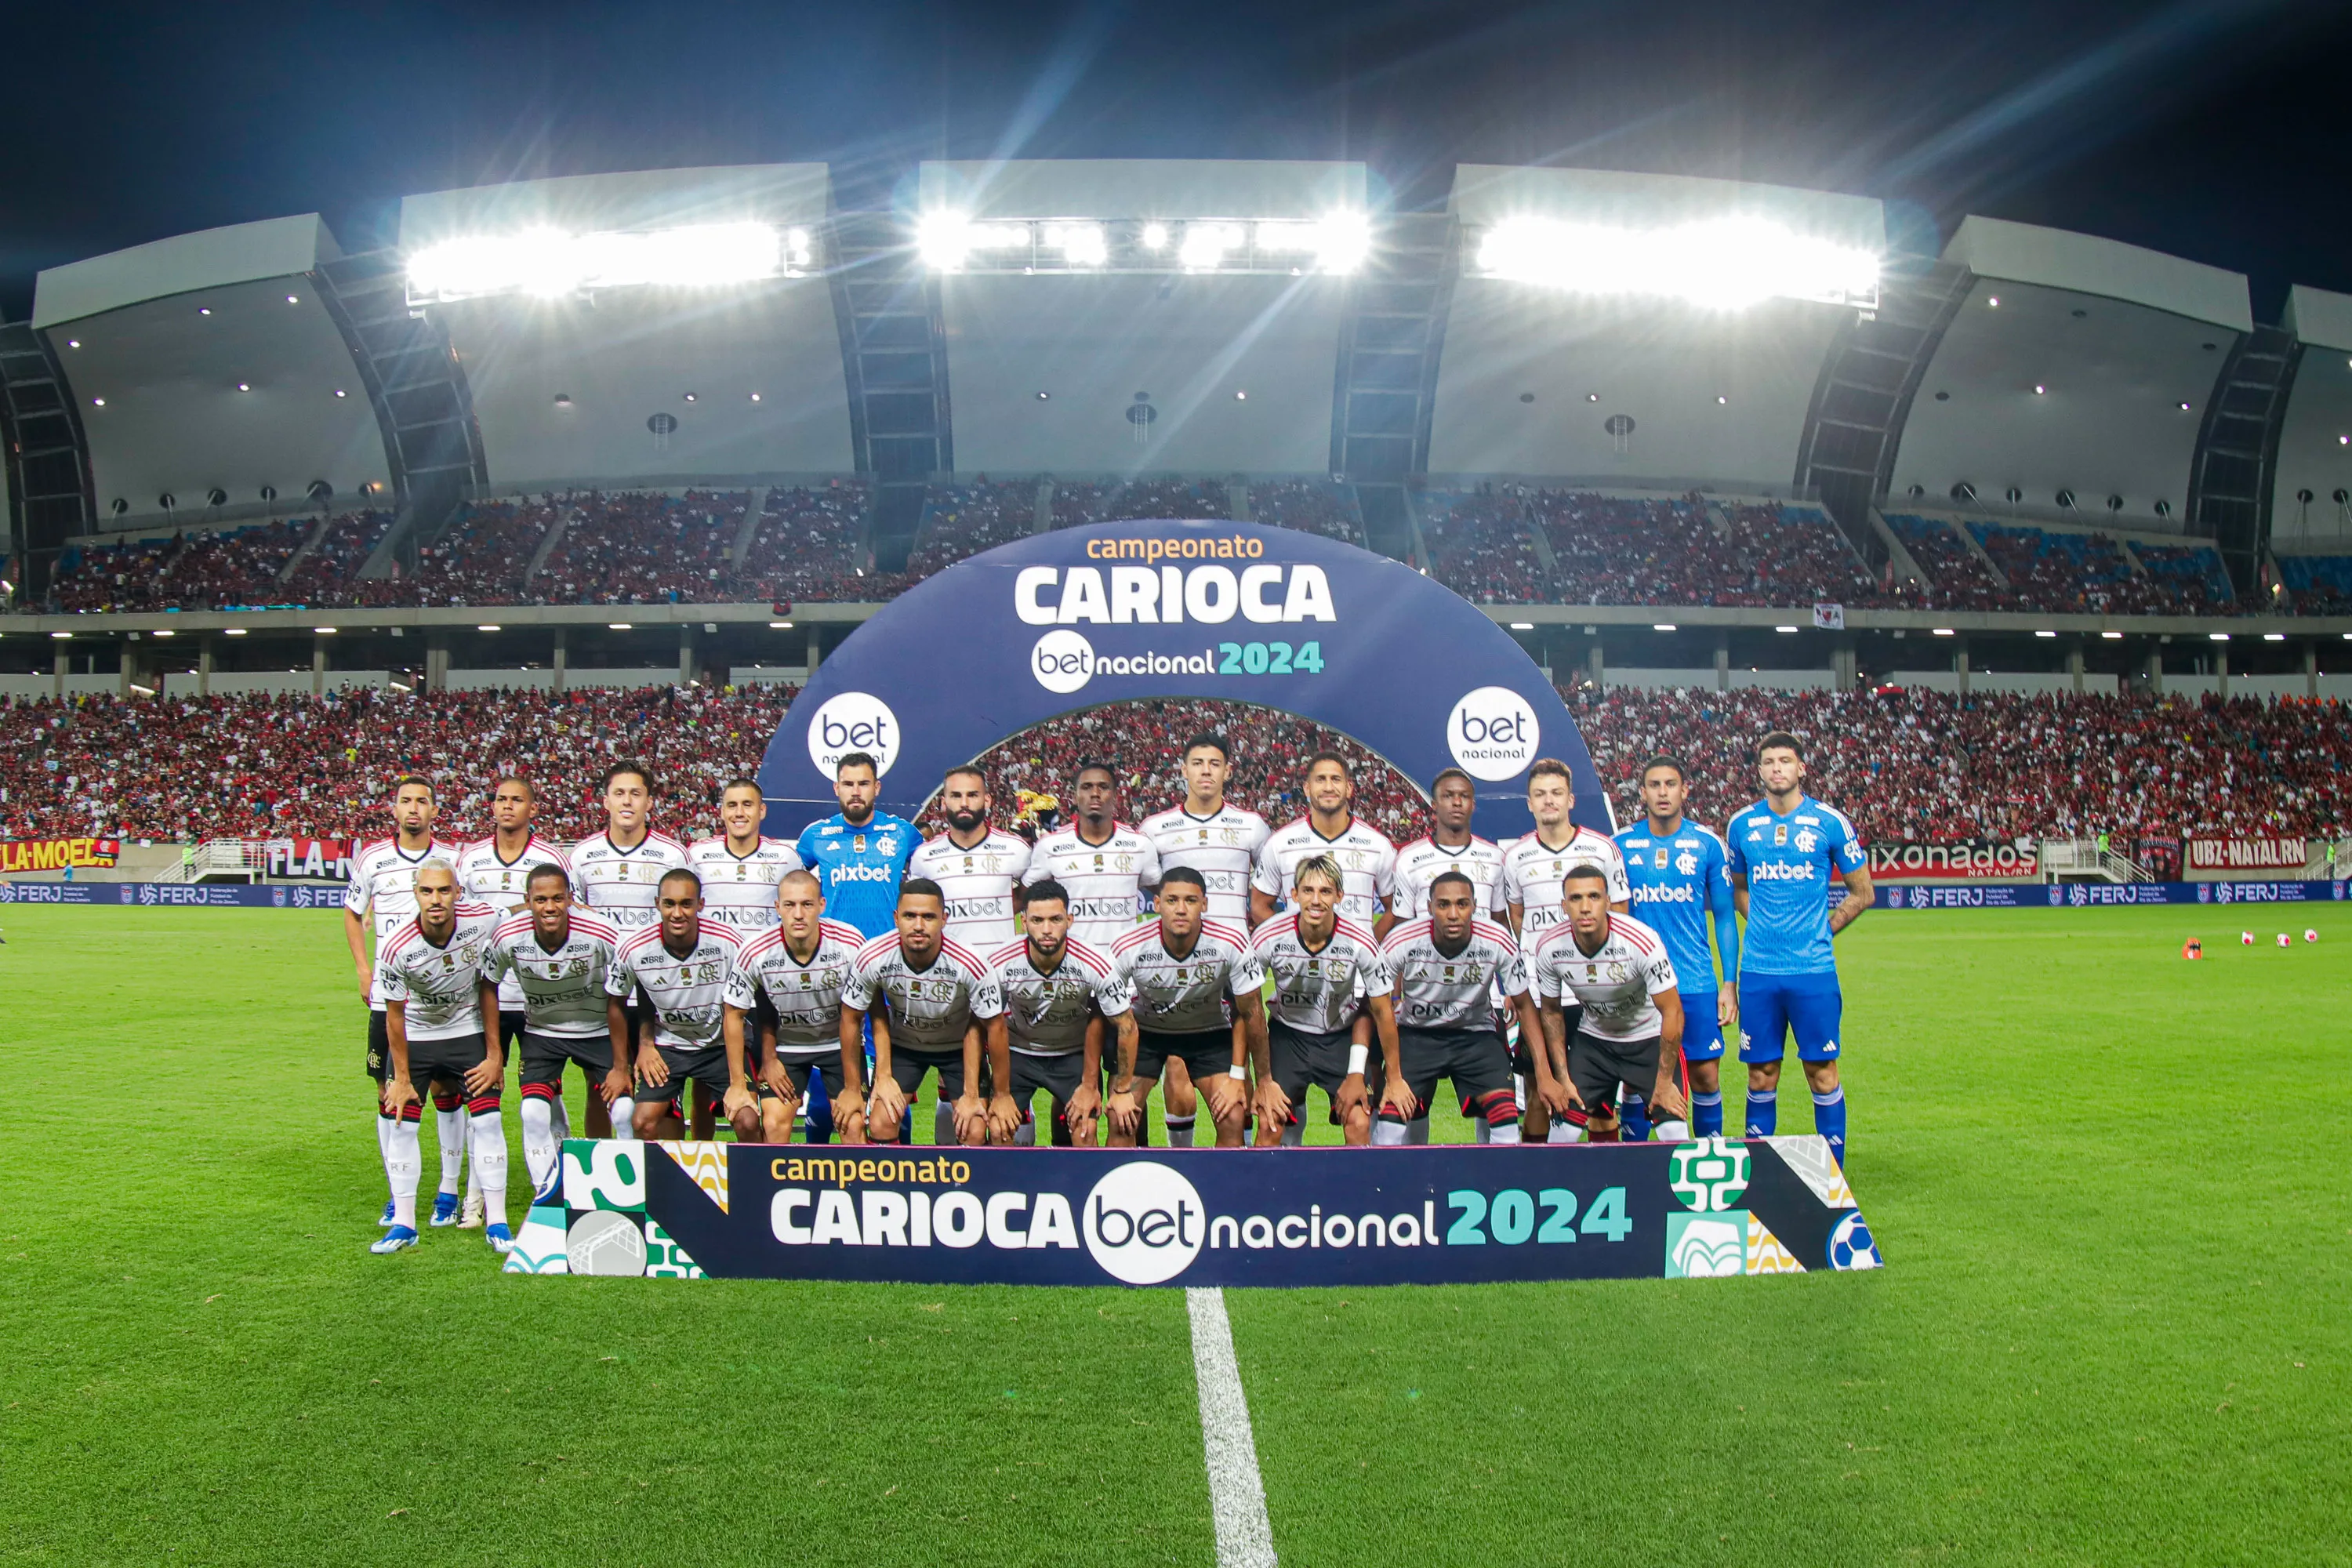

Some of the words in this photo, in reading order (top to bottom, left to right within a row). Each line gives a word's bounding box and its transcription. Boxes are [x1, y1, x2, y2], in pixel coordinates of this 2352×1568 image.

[1087, 534, 1263, 564] campeonato
[1014, 564, 1338, 625] CARIOCA
[1038, 647, 1089, 674] bet
[1096, 648, 1215, 675] nacional
[1218, 641, 1325, 675] 2024
[823, 714, 886, 748] bet
[1462, 709, 1526, 742] bet
[822, 753, 885, 764] naal
[1462, 747, 1525, 759] nacional
[649, 849, 664, 858] BRB
[383, 858, 397, 867] BRB
[1752, 858, 1814, 884] pixbet
[830, 862, 891, 887] pixbet
[18, 886, 61, 902] FERJ
[160, 887, 208, 904] FERJ
[1632, 883, 1694, 906] pixbet
[1932, 888, 1983, 906] FERJ
[2090, 886, 2136, 903] FERJ
[2235, 884, 2278, 901] FERJ
[1072, 898, 1131, 916] pixbet
[462, 926, 478, 938] BRB
[413, 949, 428, 960] BRB
[1281, 943, 1296, 952] BRB
[769, 959, 784, 967] BRB
[1147, 953, 1163, 962] BRB
[887, 964, 902, 972] BRB
[942, 968, 957, 977] BRB
[1068, 967, 1082, 976] BRB
[728, 971, 746, 989] Fla
[1105, 979, 1123, 997] Fla
[980, 984, 996, 1001] Fla
[771, 1156, 971, 1189] campeonato
[770, 1188, 1080, 1250] CARIOCA
[1095, 1194, 1194, 1247] bet
[1210, 1200, 1439, 1248] nacional
[1446, 1186, 1633, 1245] 2024
